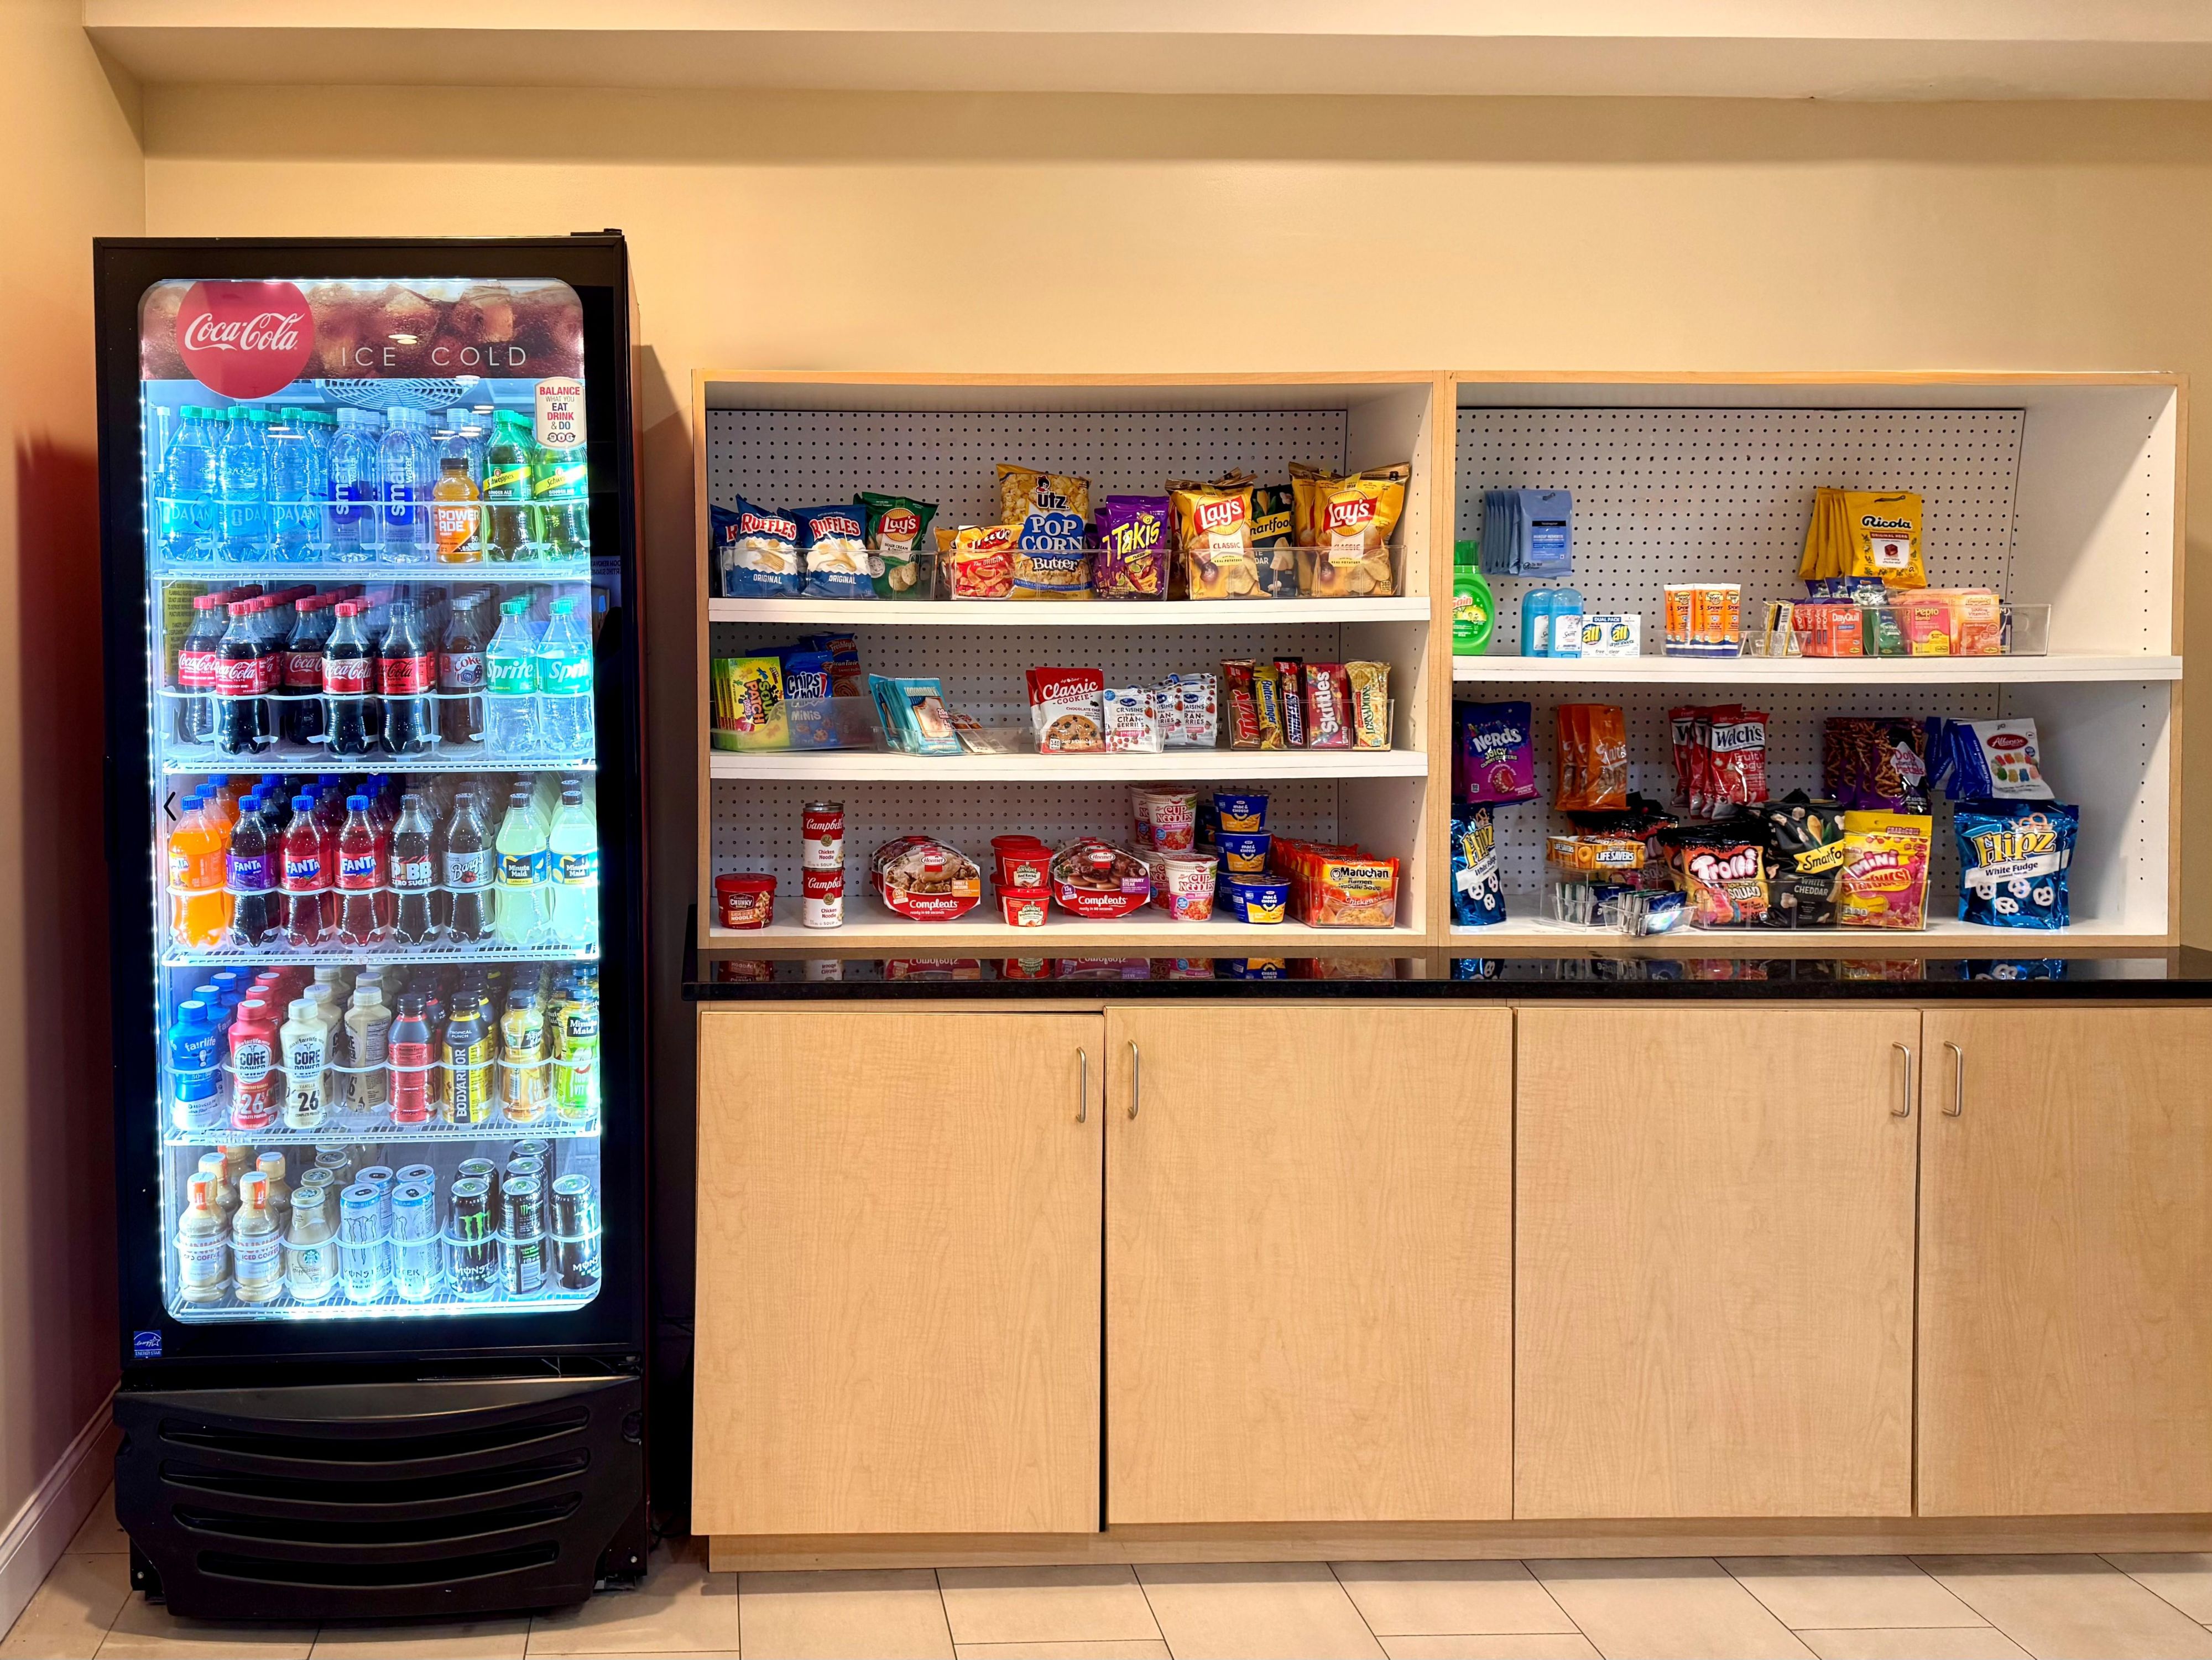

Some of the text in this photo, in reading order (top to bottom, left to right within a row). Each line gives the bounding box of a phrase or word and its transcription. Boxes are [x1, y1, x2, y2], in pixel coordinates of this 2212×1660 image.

[185, 313, 305, 351] Coca-Cola
[342, 347, 526, 367] ICE COLD
[540, 387, 580, 395] BALANCE
[547, 412, 574, 420] DRINK
[551, 421, 571, 430] & DO
[404, 456, 414, 483] water
[389, 455, 405, 517] smart
[439, 509, 479, 521] POWER
[1199, 500, 1243, 529] Lay's
[1328, 498, 1370, 527] Lay's
[439, 521, 465, 532] ADE
[740, 513, 797, 540] RUFFLES
[809, 516, 860, 540] RUFFLES
[885, 516, 916, 534] Lay's
[1030, 517, 1077, 536] POP
[1861, 516, 1911, 529] Ricola
[1021, 535, 1084, 554] CORN
[1112, 516, 1161, 560] Takis
[1033, 557, 1078, 571] Butter
[753, 574, 782, 584] ORIGINAL
[829, 575, 856, 585] ORIGINAL
[1832, 613, 1859, 623] DayQuil
[1915, 608, 1939, 616] Pepto
[1583, 625, 1600, 642] all
[1613, 625, 1628, 642] all
[325, 659, 371, 680] Coca-Cola
[487, 658, 533, 682] Sprite
[787, 672, 820, 694] Chips
[1042, 678, 1098, 700] Classic
[747, 680, 765, 724] PATCH
[1232, 689, 1259, 739] TWIX
[1716, 727, 1762, 747] Welch's
[1485, 748, 1507, 760] JUICY
[1164, 805, 1187, 814] CUP
[1157, 813, 1192, 823] NOODLES
[1973, 831, 2057, 869] Flipz
[234, 860, 261, 872] FANTA
[285, 858, 320, 873] FANTA
[341, 856, 376, 871] FANTA
[1691, 848, 1757, 880] Trolli
[1803, 847, 1842, 870] Smartfo
[451, 854, 485, 882] Barq's
[1340, 867, 1389, 878] Maruchan
[1985, 861, 2038, 877] White Fudge
[408, 878, 431, 886] SUGAR
[1188, 874, 1212, 882] CUP
[1801, 877, 1825, 887] WHITE
[1179, 881, 1214, 892] NOODLES
[1729, 886, 1761, 899] SQUAD
[1794, 885, 1828, 896] CHEDDAR
[910, 898, 958, 910] Compleats
[1079, 895, 1126, 907] Compleats
[1345, 897, 1374, 906] Chicken
[240, 1050, 265, 1065] CORE
[294, 1049, 320, 1064] CORE
[258, 1247, 278, 1260] COFFEE
